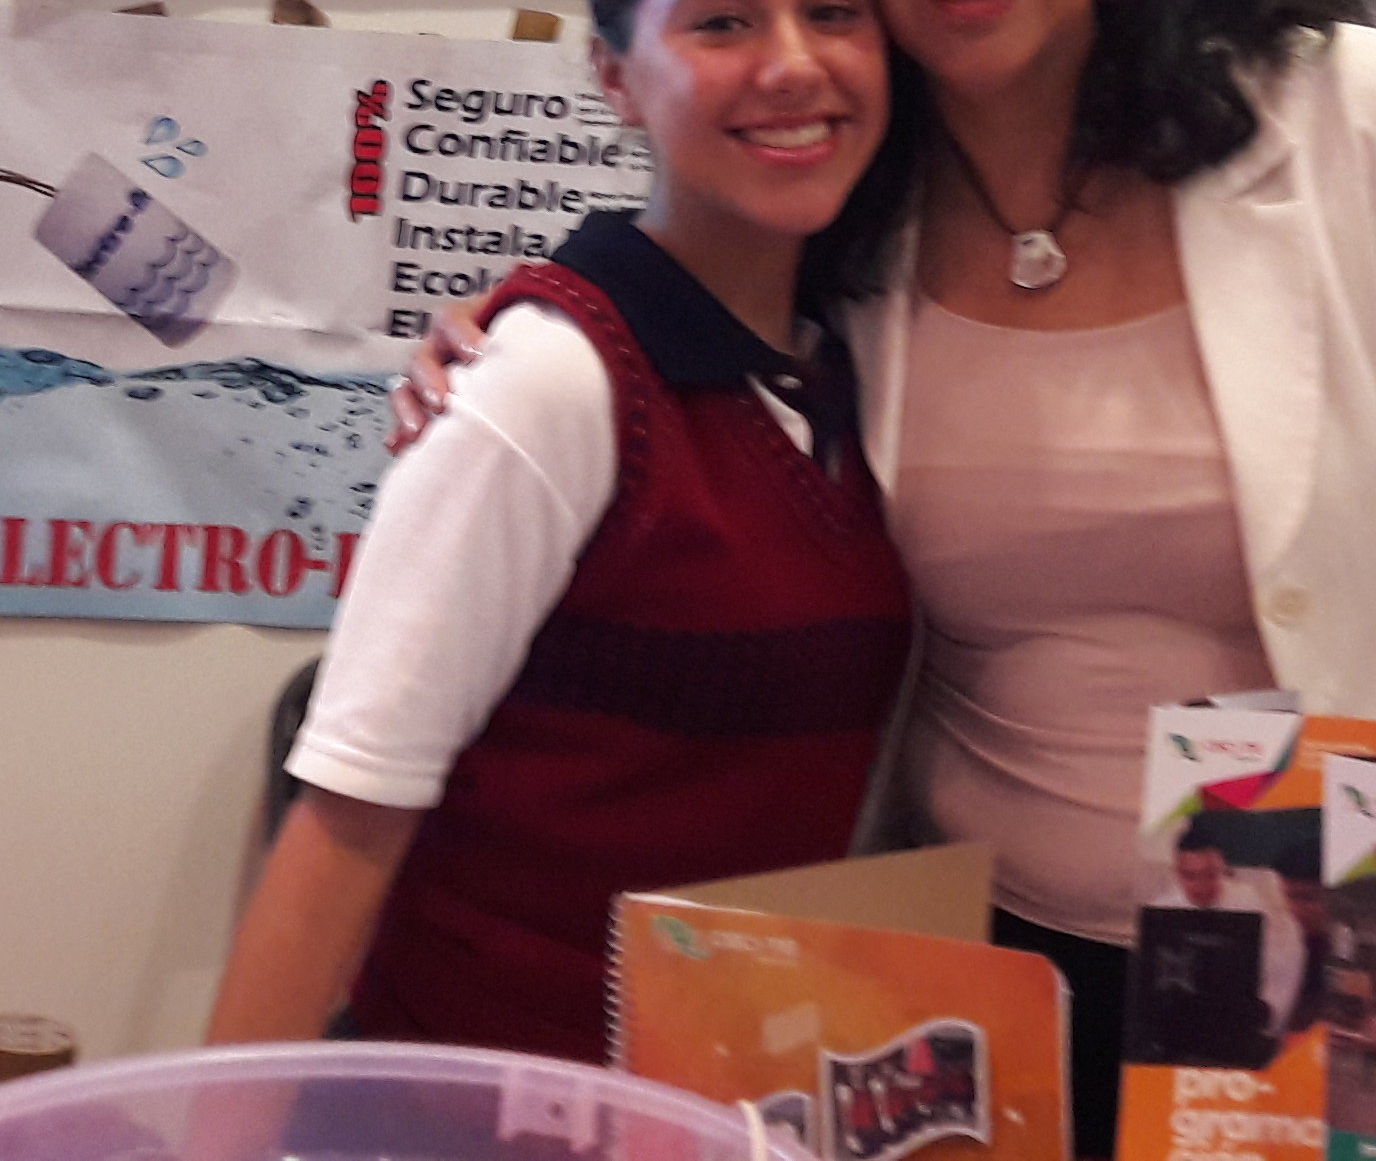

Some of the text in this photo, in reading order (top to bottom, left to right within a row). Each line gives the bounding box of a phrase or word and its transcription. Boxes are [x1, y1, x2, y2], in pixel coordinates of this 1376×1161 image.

[404, 78, 570, 123] Seguro
[349, 79, 390, 223] 100%
[403, 124, 622, 167] Confiable
[400, 171, 585, 214] Durable
[391, 261, 504, 298] Ecol
[1174, 1069, 1275, 1108] pro-
